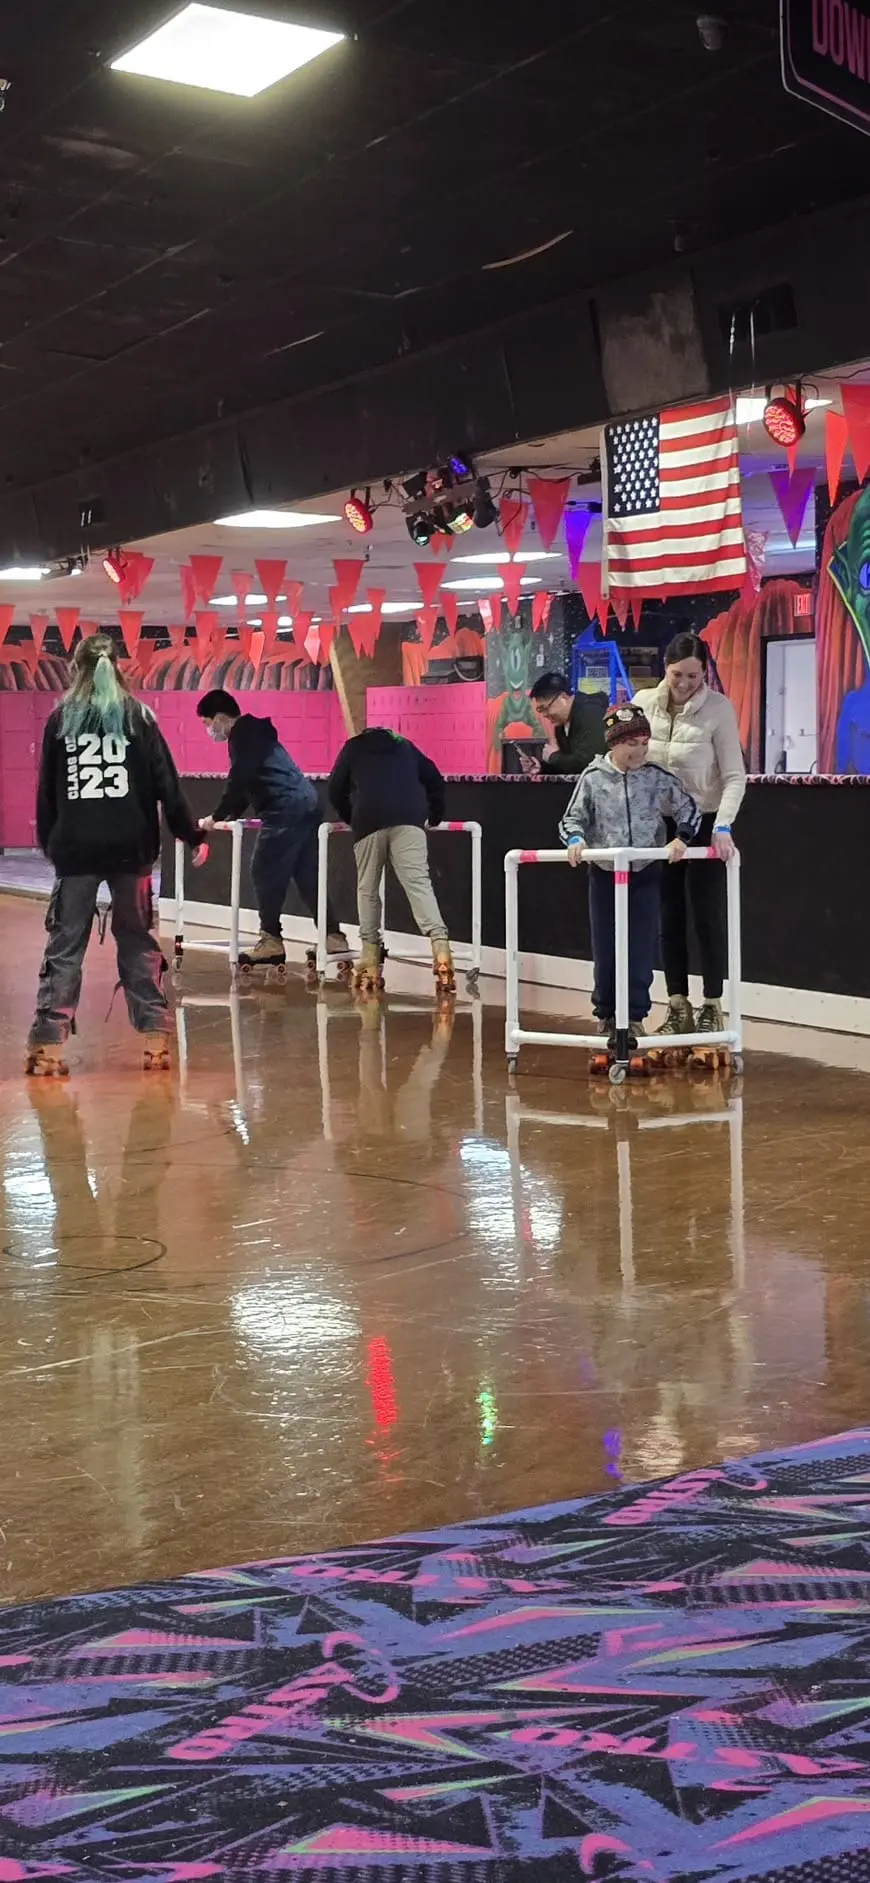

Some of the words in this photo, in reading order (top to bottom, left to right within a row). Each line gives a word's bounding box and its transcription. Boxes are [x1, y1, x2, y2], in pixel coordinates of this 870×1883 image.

[811, 0, 870, 84] DOW
[78, 733, 127, 765] 20
[67, 756, 79, 800] CLASS
[79, 766, 129, 799] 23
